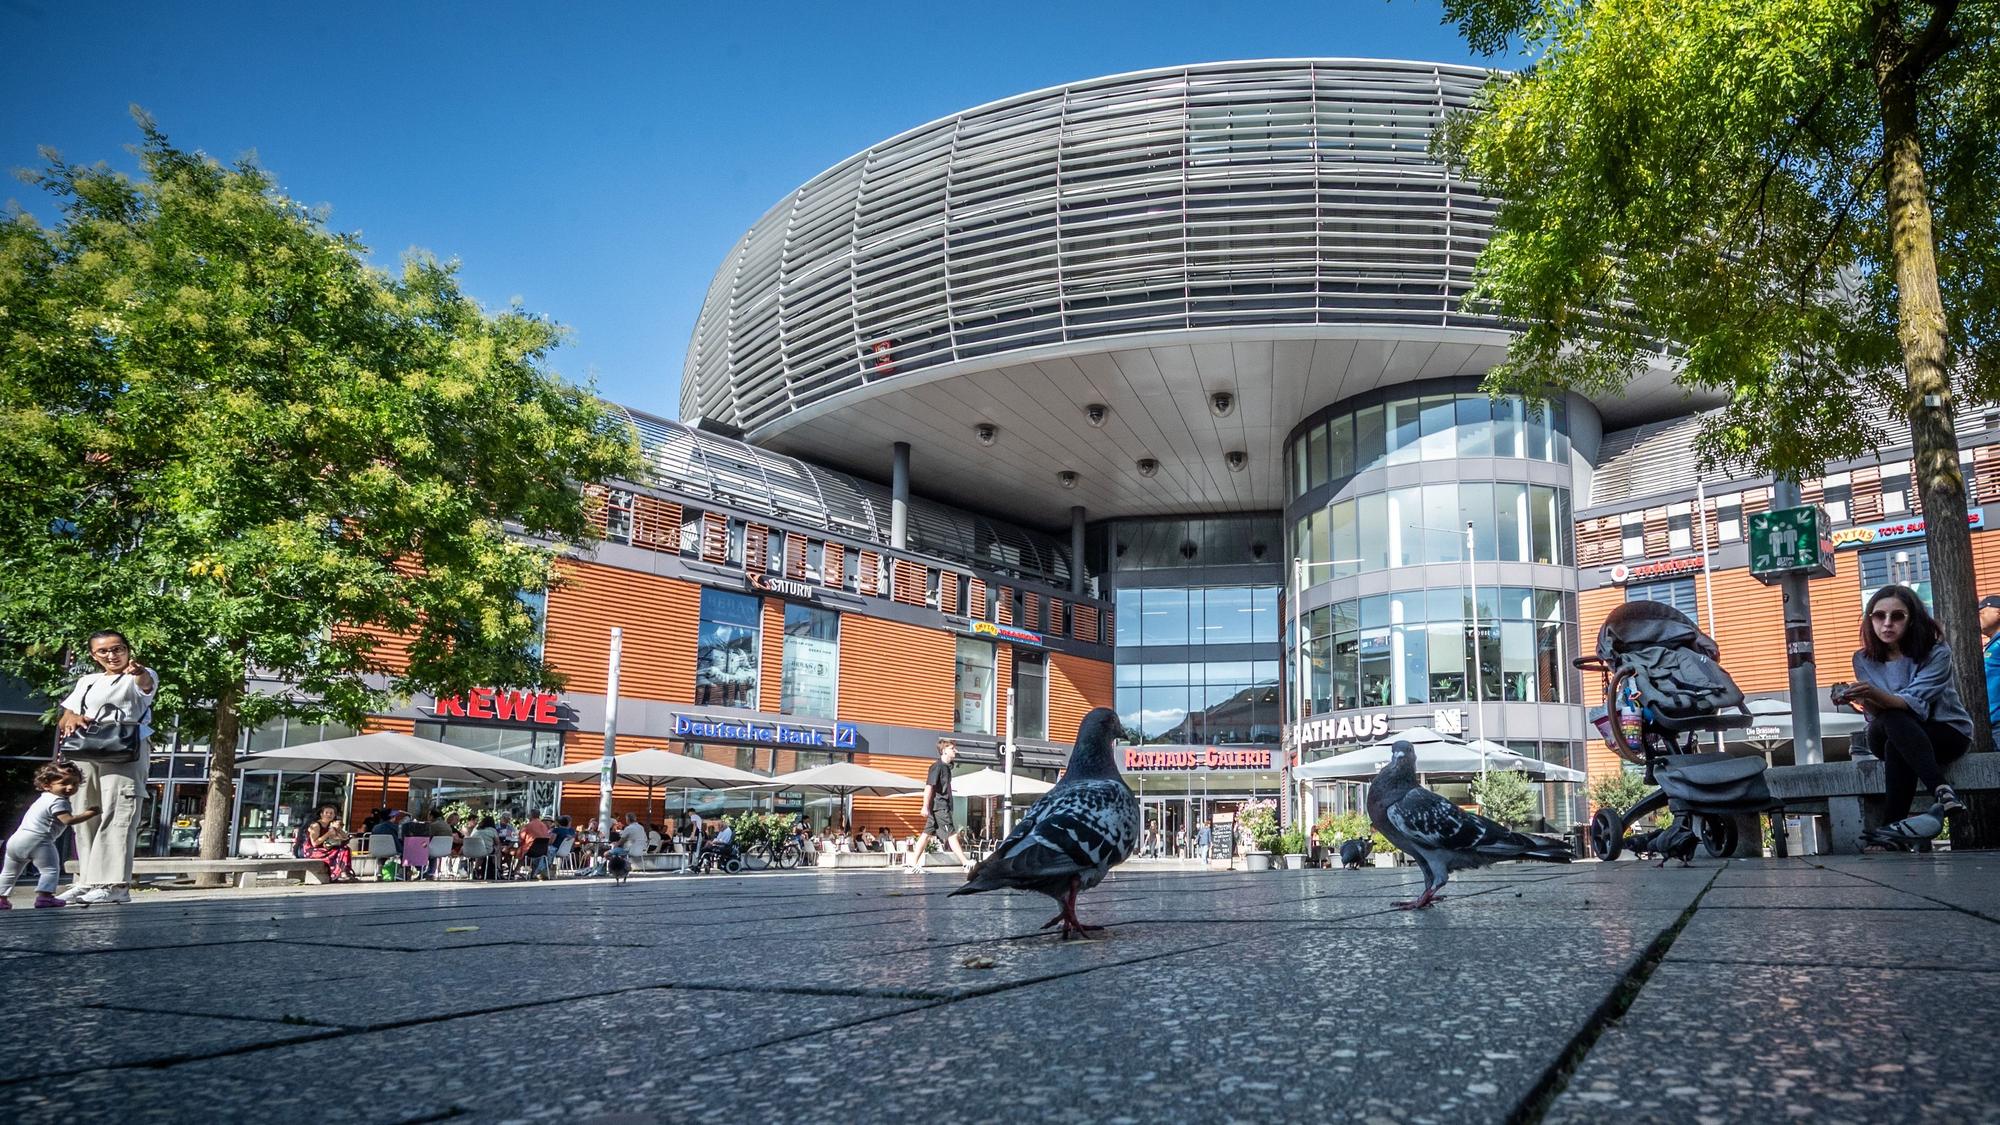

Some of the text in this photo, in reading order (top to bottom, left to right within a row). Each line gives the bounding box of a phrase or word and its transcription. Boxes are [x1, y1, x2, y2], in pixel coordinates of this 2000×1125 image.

[1831, 529, 1873, 545] MYTHS
[769, 578, 812, 598] SATURN
[434, 686, 558, 724] REWE
[675, 715, 823, 746] Deutsche Bank
[1293, 713, 1388, 745] RATHAUS
